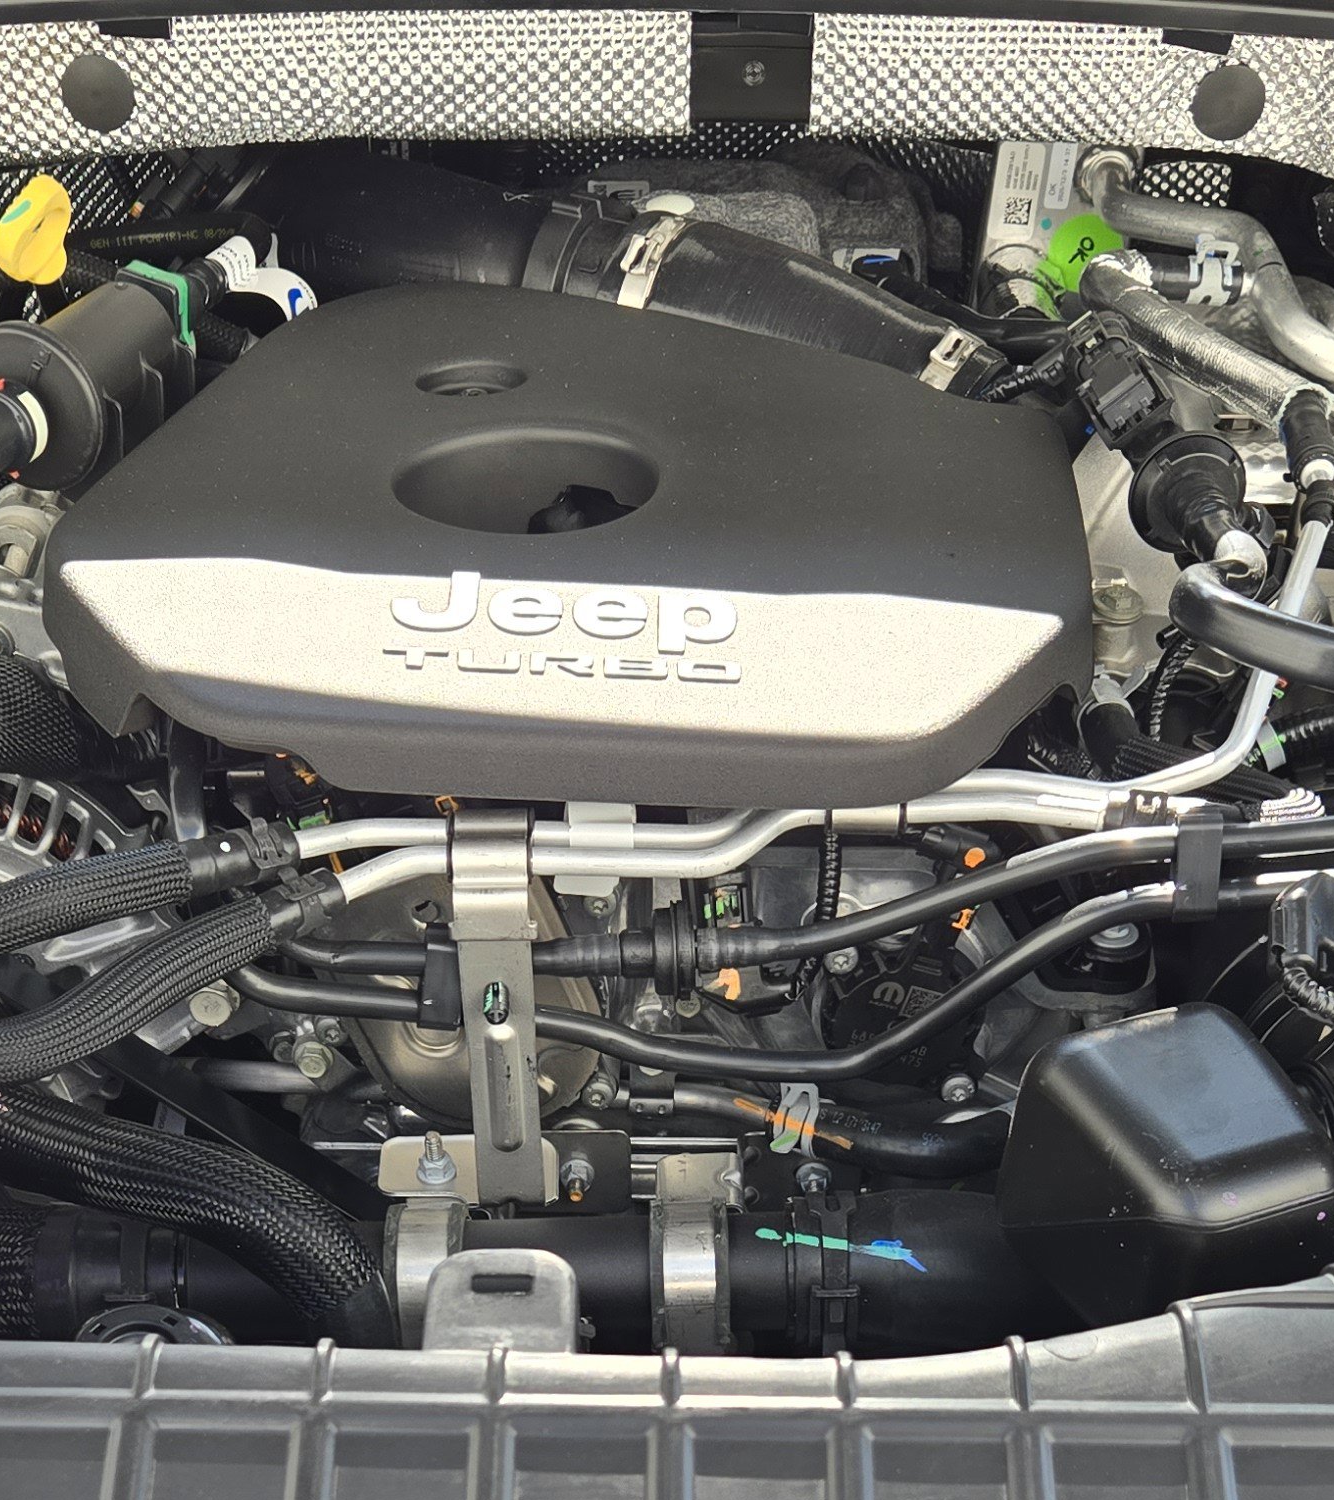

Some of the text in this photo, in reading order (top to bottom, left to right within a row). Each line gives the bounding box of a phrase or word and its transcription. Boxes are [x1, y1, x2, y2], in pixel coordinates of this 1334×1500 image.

[89, 238, 110, 249] GEN
[1068, 237, 1095, 264] OK
[390, 571, 739, 655] Jeep
[382, 645, 742, 684] TURBO
